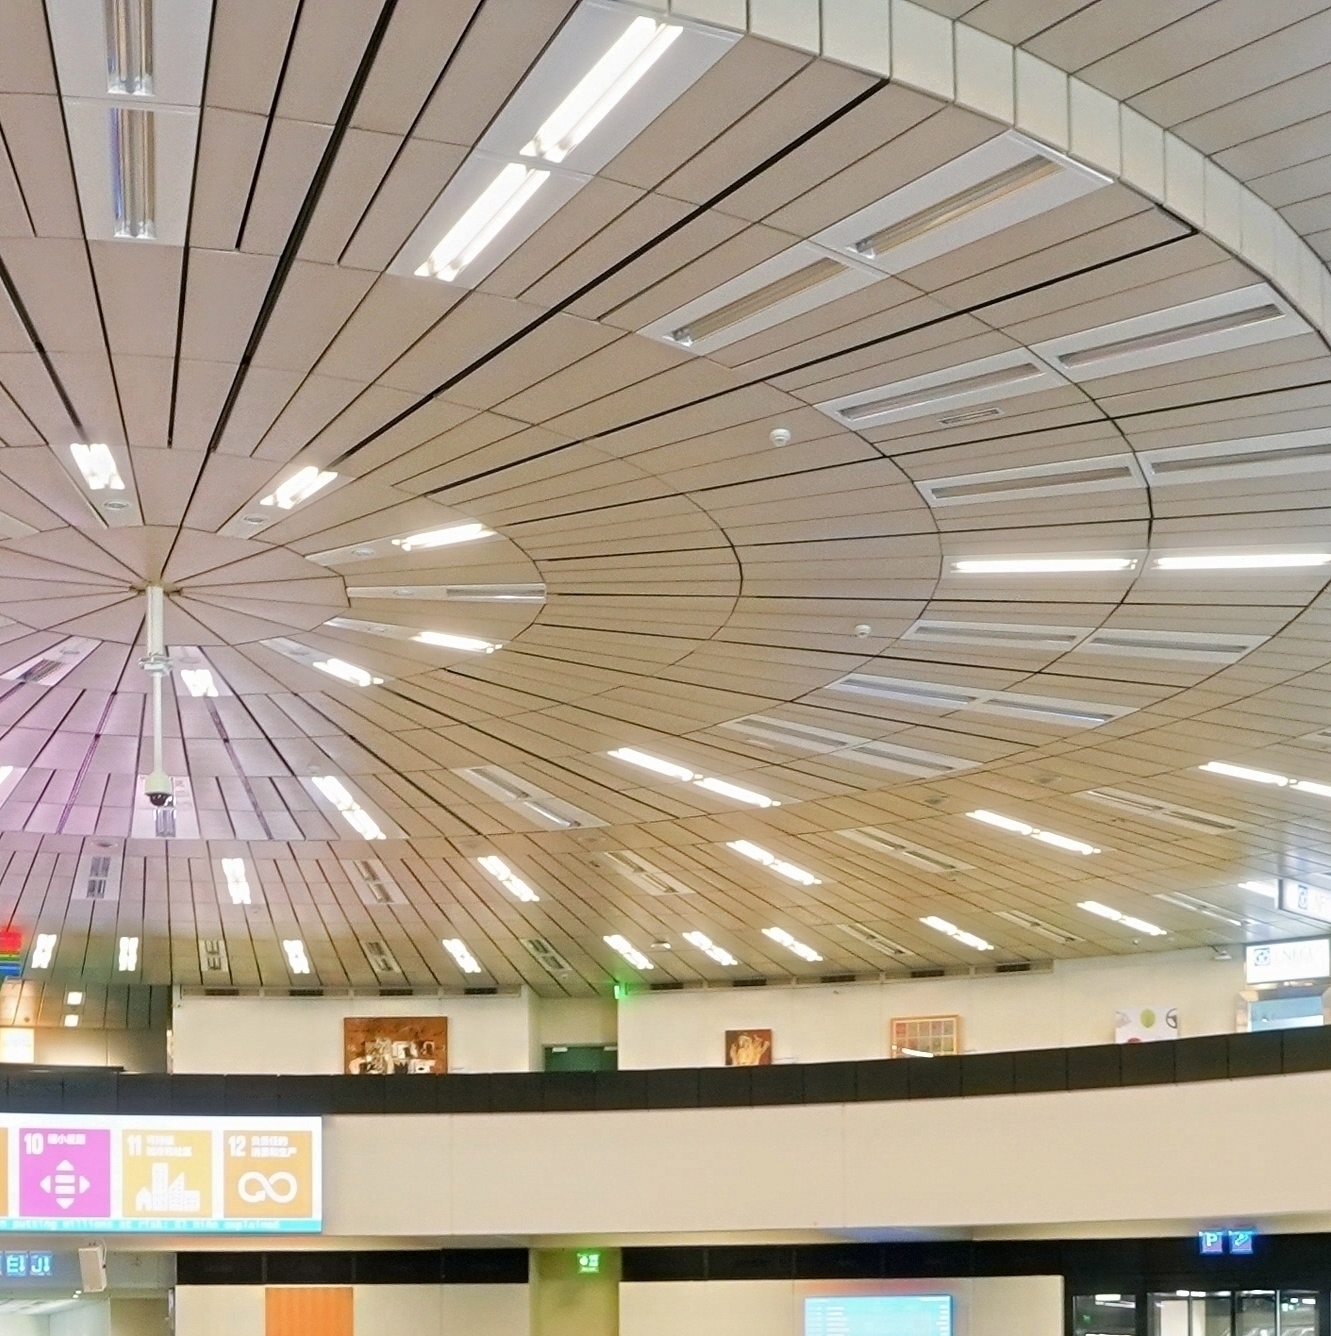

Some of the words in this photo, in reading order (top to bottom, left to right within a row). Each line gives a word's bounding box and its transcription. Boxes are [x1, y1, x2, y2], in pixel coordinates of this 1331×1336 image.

[24, 1132, 44, 1155] 10
[127, 1134, 142, 1156] 11
[228, 1135, 247, 1157] 12
[1205, 1232, 1218, 1247] P
[6, 1256, 19, 1273] E
